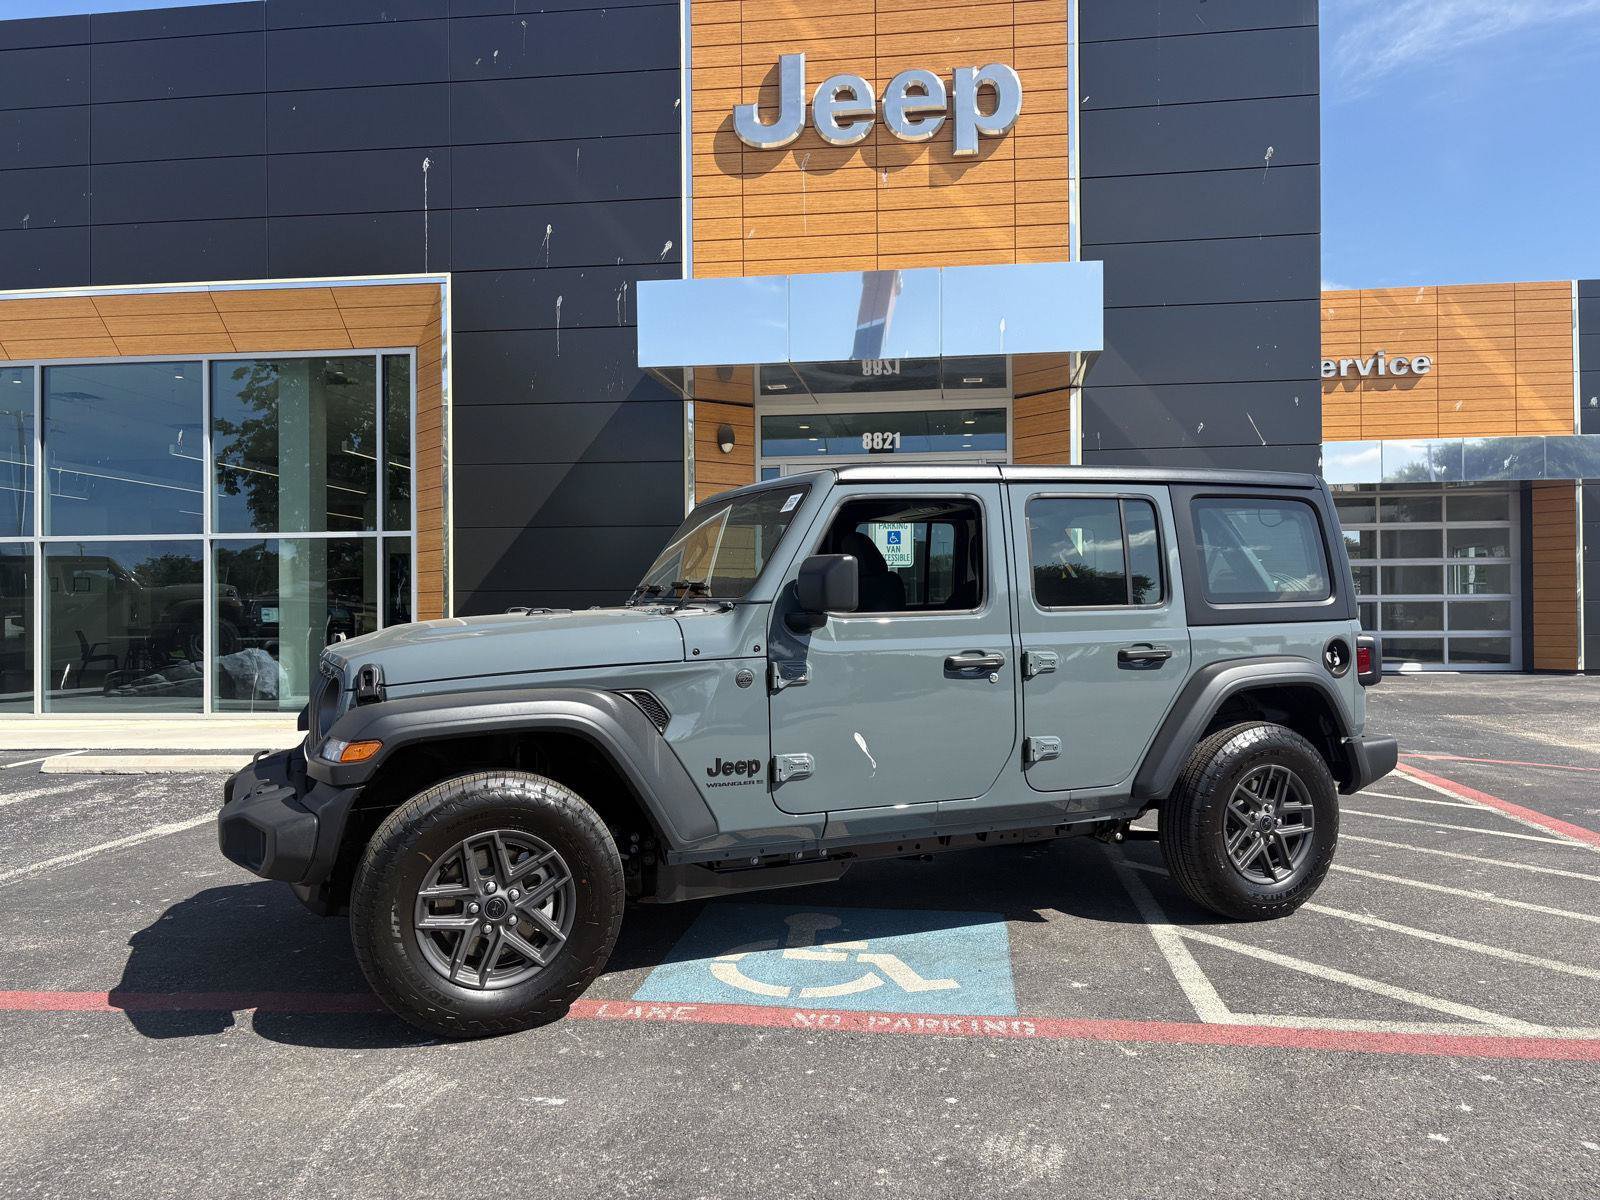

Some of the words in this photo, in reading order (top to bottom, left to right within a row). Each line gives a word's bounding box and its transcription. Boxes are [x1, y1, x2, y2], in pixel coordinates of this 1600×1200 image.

[733, 53, 1022, 156] Jeep
[1321, 350, 1432, 378] ervice
[862, 432, 900, 449] 8821
[707, 757, 761, 778] Jeep
[705, 780, 755, 788] WRANGLER
[596, 1003, 697, 1021] LANE
[792, 1012, 842, 1027] NO
[867, 1015, 1037, 1036] PARKING
